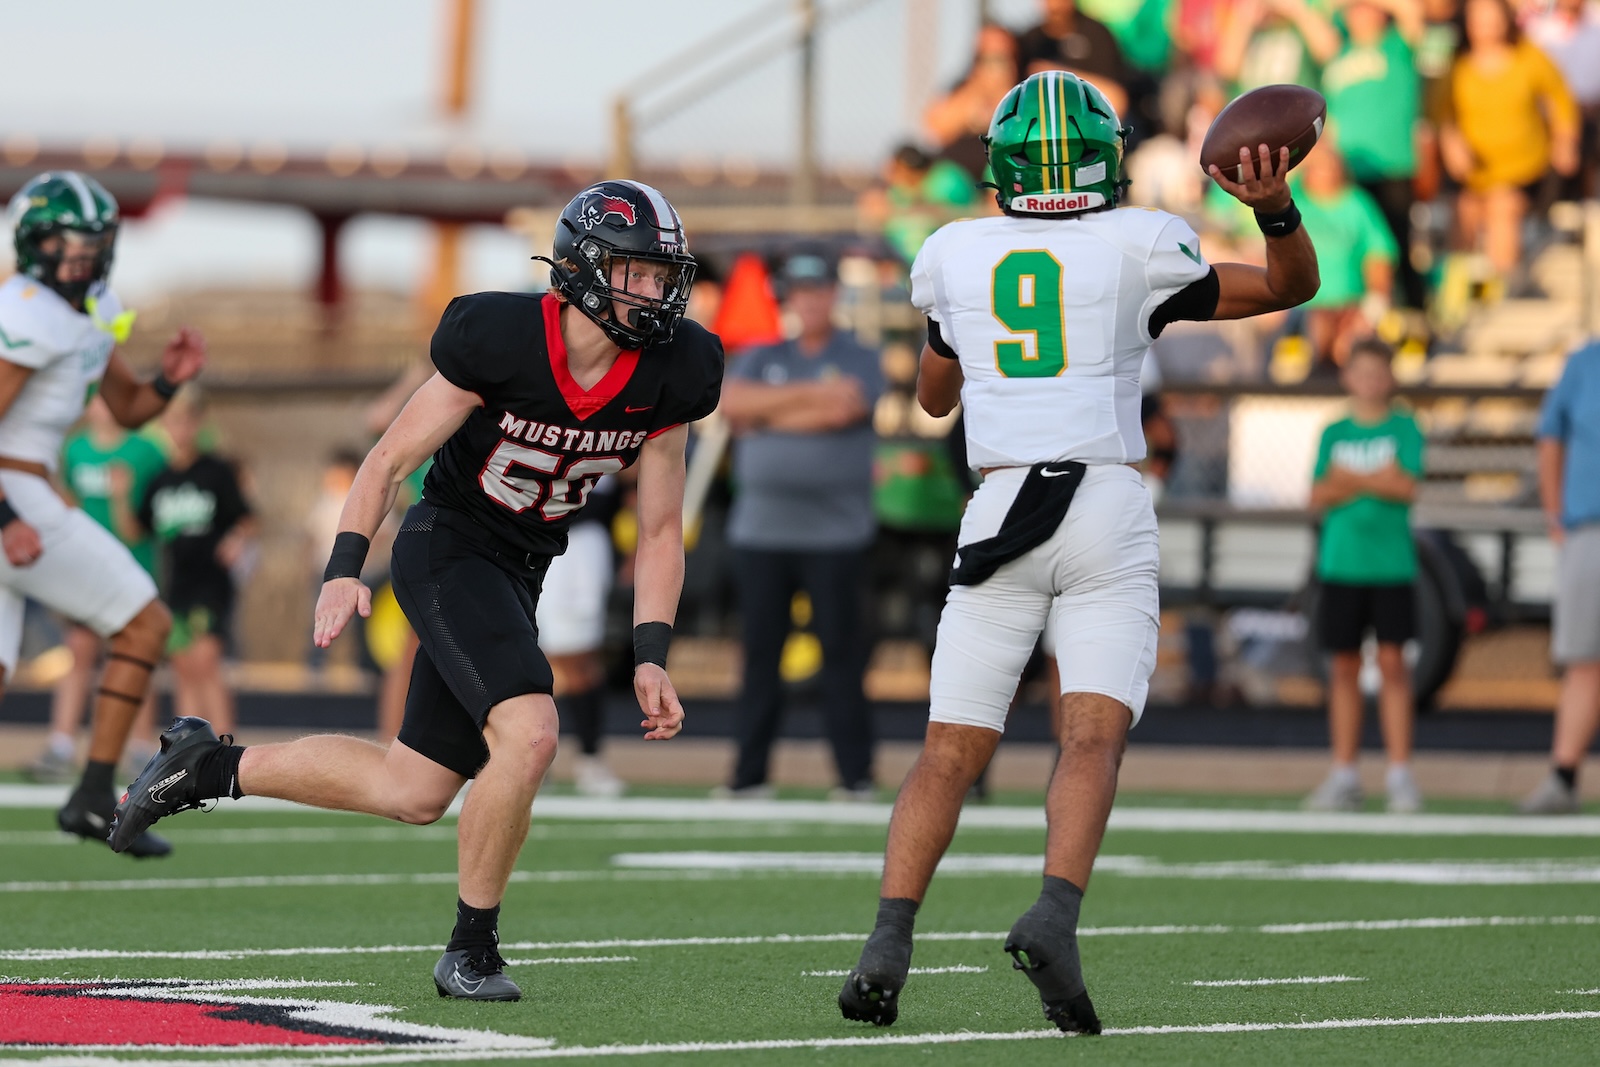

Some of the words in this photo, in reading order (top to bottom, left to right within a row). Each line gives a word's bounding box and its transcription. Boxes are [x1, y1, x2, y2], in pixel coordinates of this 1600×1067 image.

[1026, 195, 1088, 211] Riddell
[660, 243, 680, 254] TNT
[990, 248, 1068, 378] 9
[498, 411, 648, 452] MUSTANGS
[477, 438, 626, 521] 50
